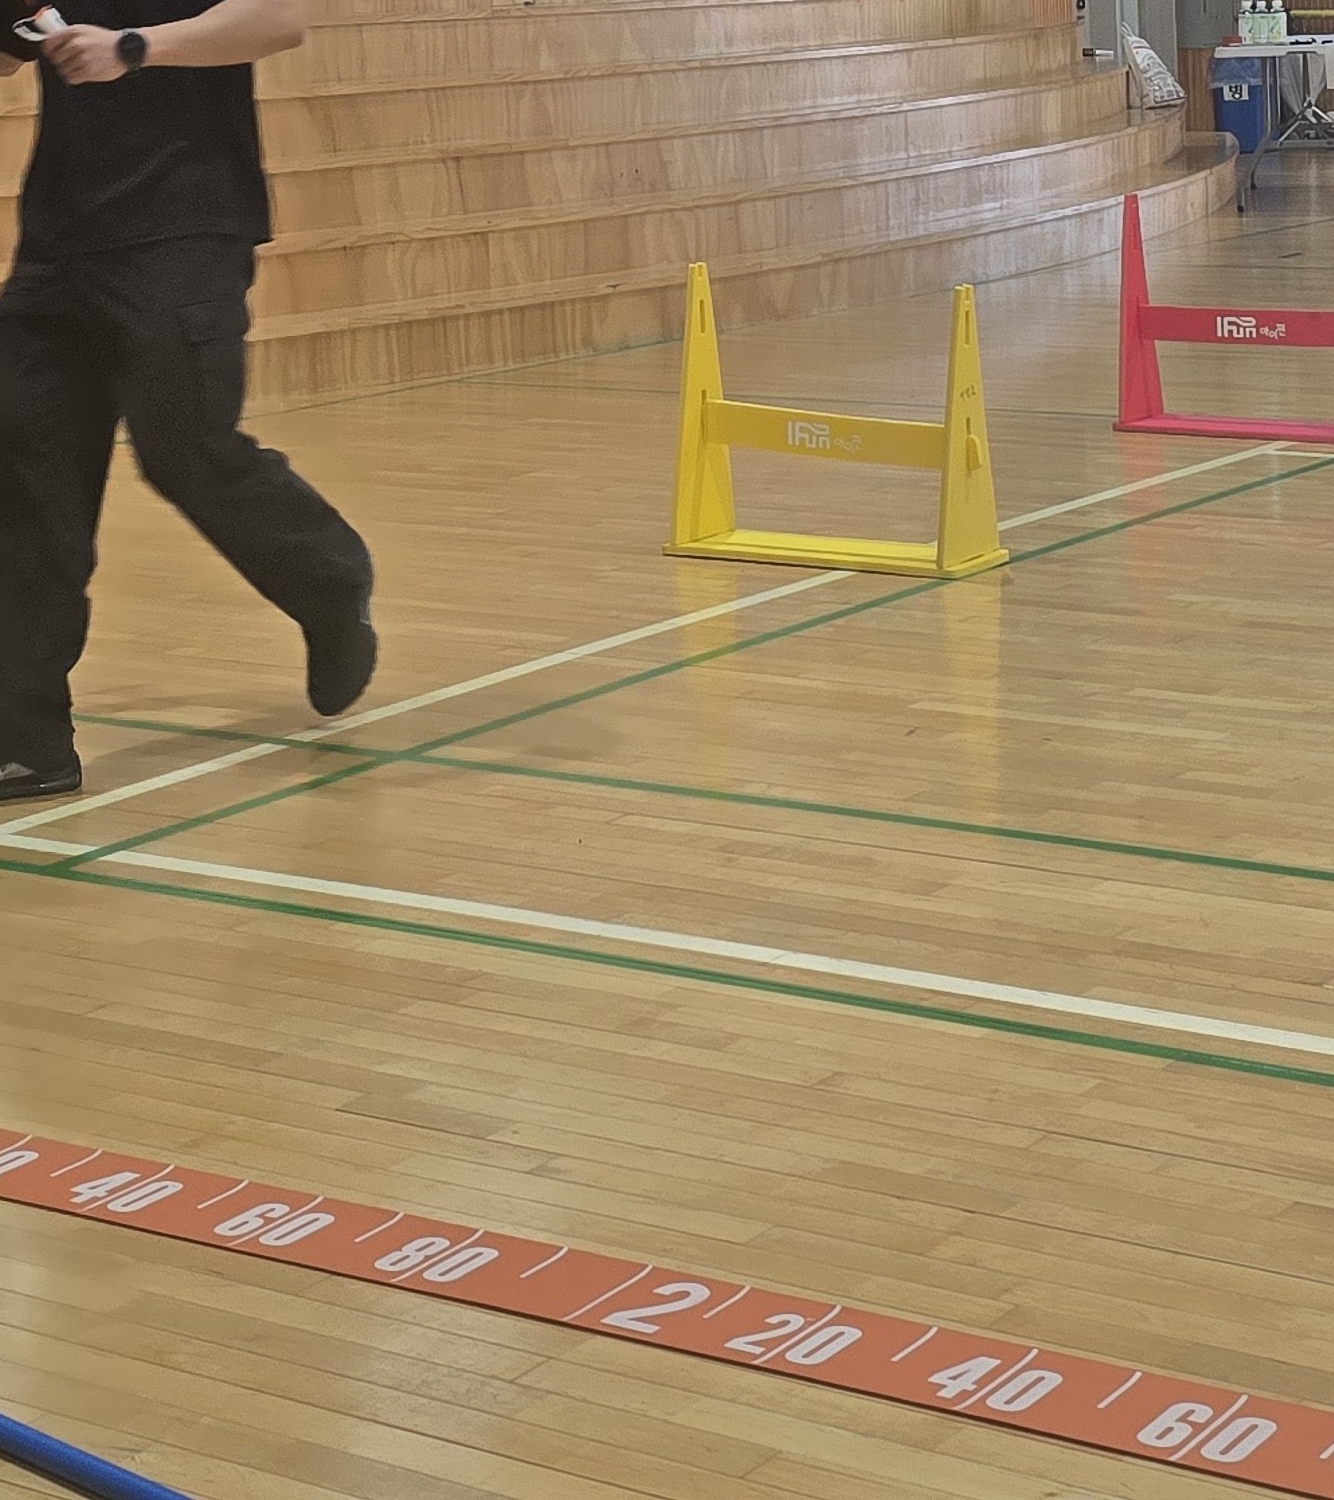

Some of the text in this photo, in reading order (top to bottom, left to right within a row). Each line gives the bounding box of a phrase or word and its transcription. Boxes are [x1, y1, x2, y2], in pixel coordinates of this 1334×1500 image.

[69, 1171, 184, 1213] 40
[213, 1203, 335, 1247] 60
[374, 1236, 500, 1282] 80
[599, 1282, 710, 1334] 2
[725, 1312, 863, 1366] 20
[927, 1356, 1063, 1413] 40
[1136, 1401, 1277, 1463] 60
